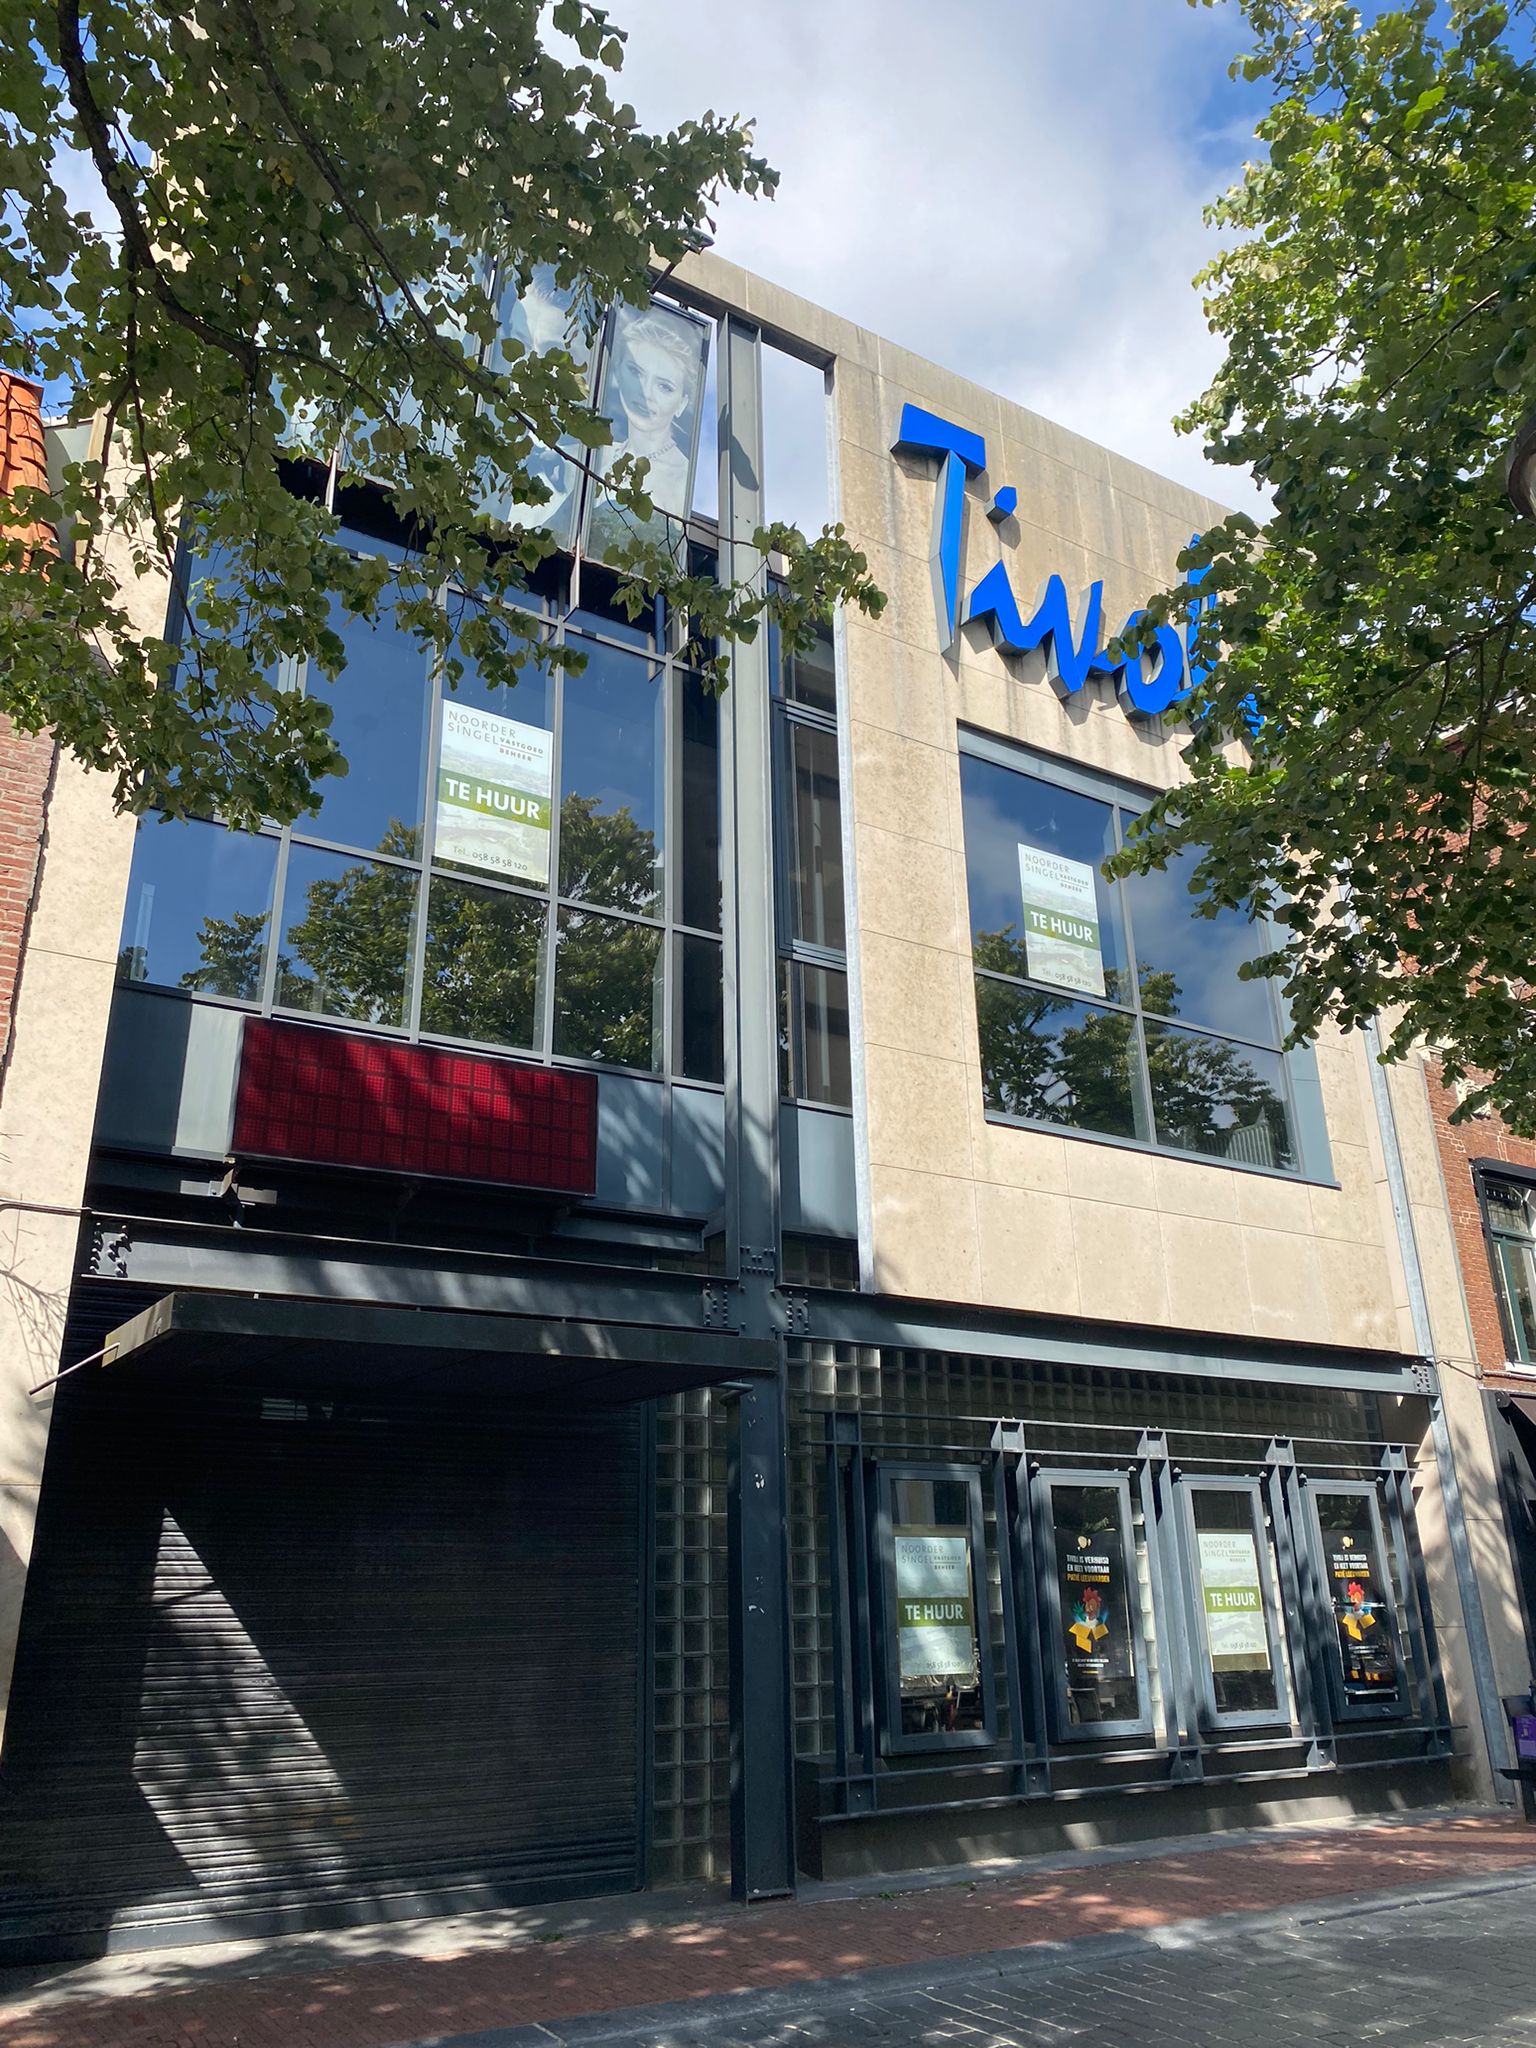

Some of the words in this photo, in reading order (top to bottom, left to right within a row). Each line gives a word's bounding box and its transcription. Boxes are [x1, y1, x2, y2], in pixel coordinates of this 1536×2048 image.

[448, 710, 517, 739] NOORDER
[447, 723, 499, 746] SINGEL
[500, 738, 545, 755] VASTGOED
[500, 748, 533, 762] BEHEER
[445, 778, 471, 801] TE
[476, 787, 540, 820] HUUR
[1025, 853, 1070, 873] NOORDER
[1025, 863, 1060, 880] SINGEL
[1030, 911, 1048, 929] TE
[1051, 917, 1094, 942] HUUR
[901, 1544, 944, 1553] NOORDER
[901, 1555, 933, 1563] SINGEL
[1210, 1593, 1222, 1607] TE
[1225, 1592, 1257, 1607] HUUR
[905, 1604, 920, 1620] TE
[924, 1604, 964, 1620] HUUR
